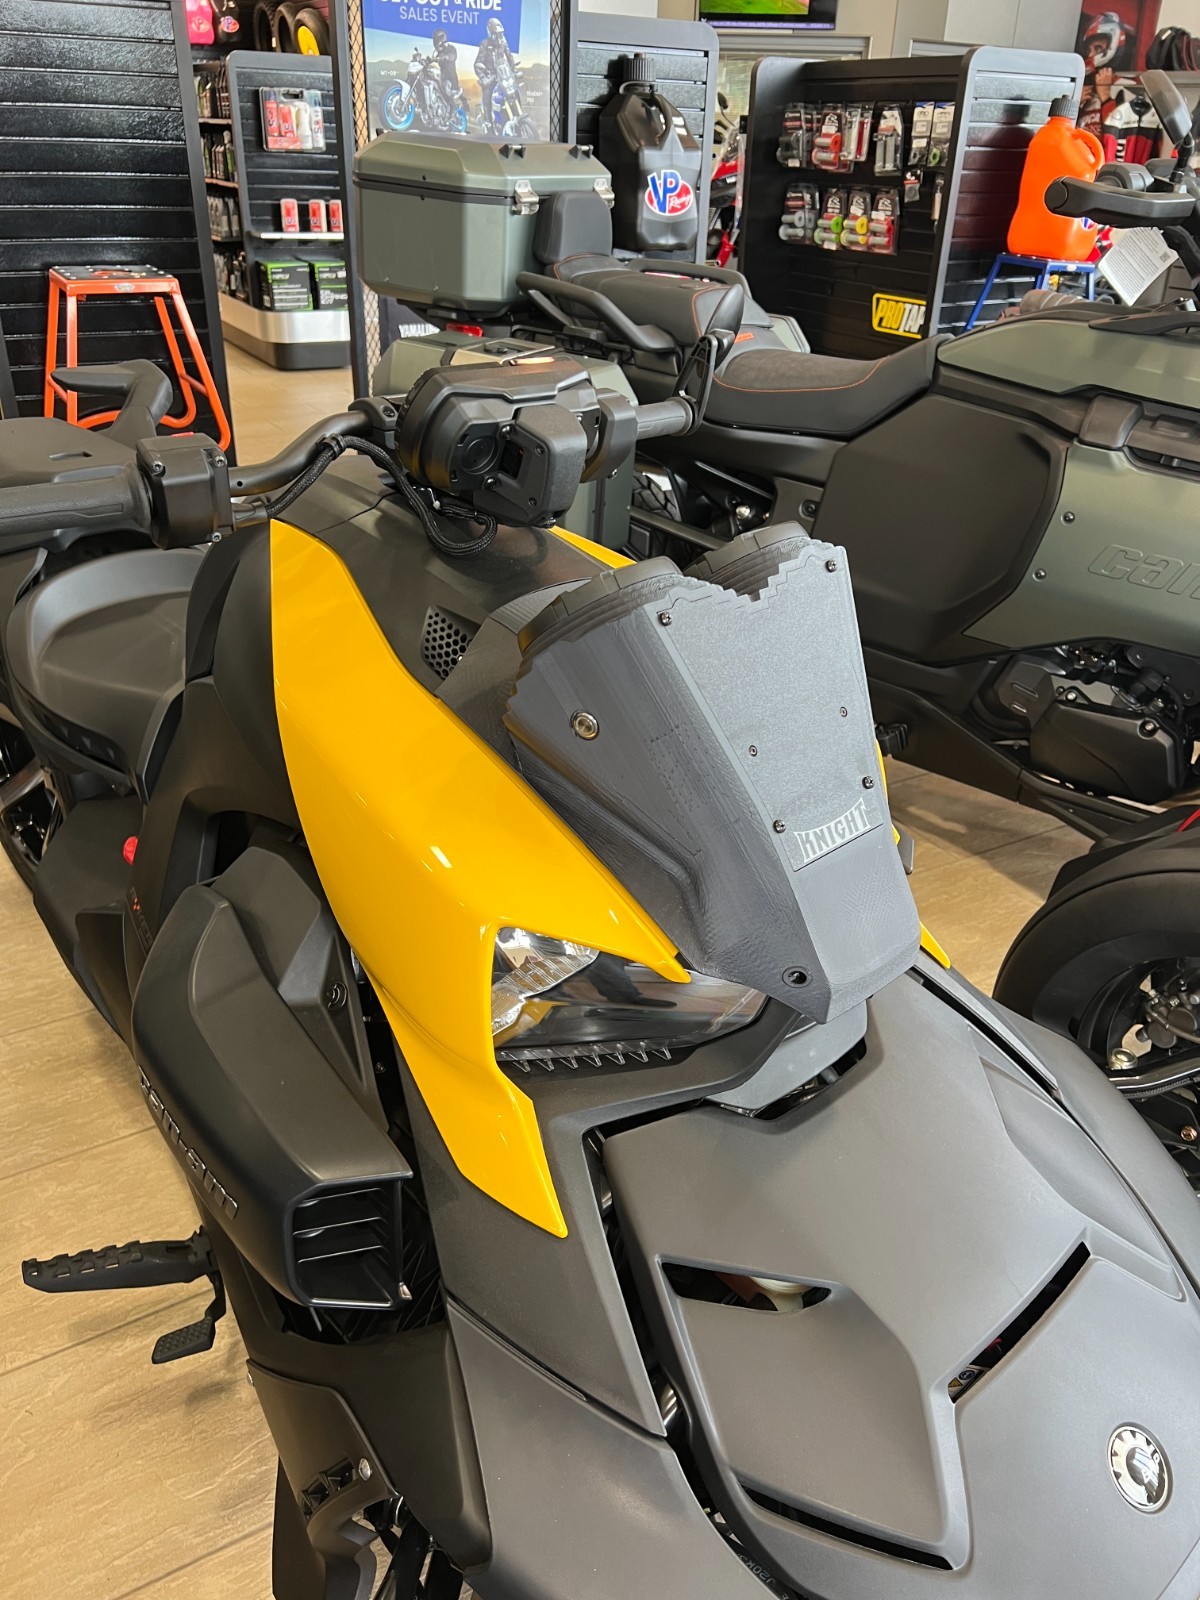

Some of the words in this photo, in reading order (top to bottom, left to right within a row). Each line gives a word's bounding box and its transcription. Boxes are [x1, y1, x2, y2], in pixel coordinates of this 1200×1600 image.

[399, 6, 438, 22] SALES
[441, 9, 480, 25] EVENT
[647, 170, 681, 214] VP
[796, 799, 869, 860] KNIGHT
